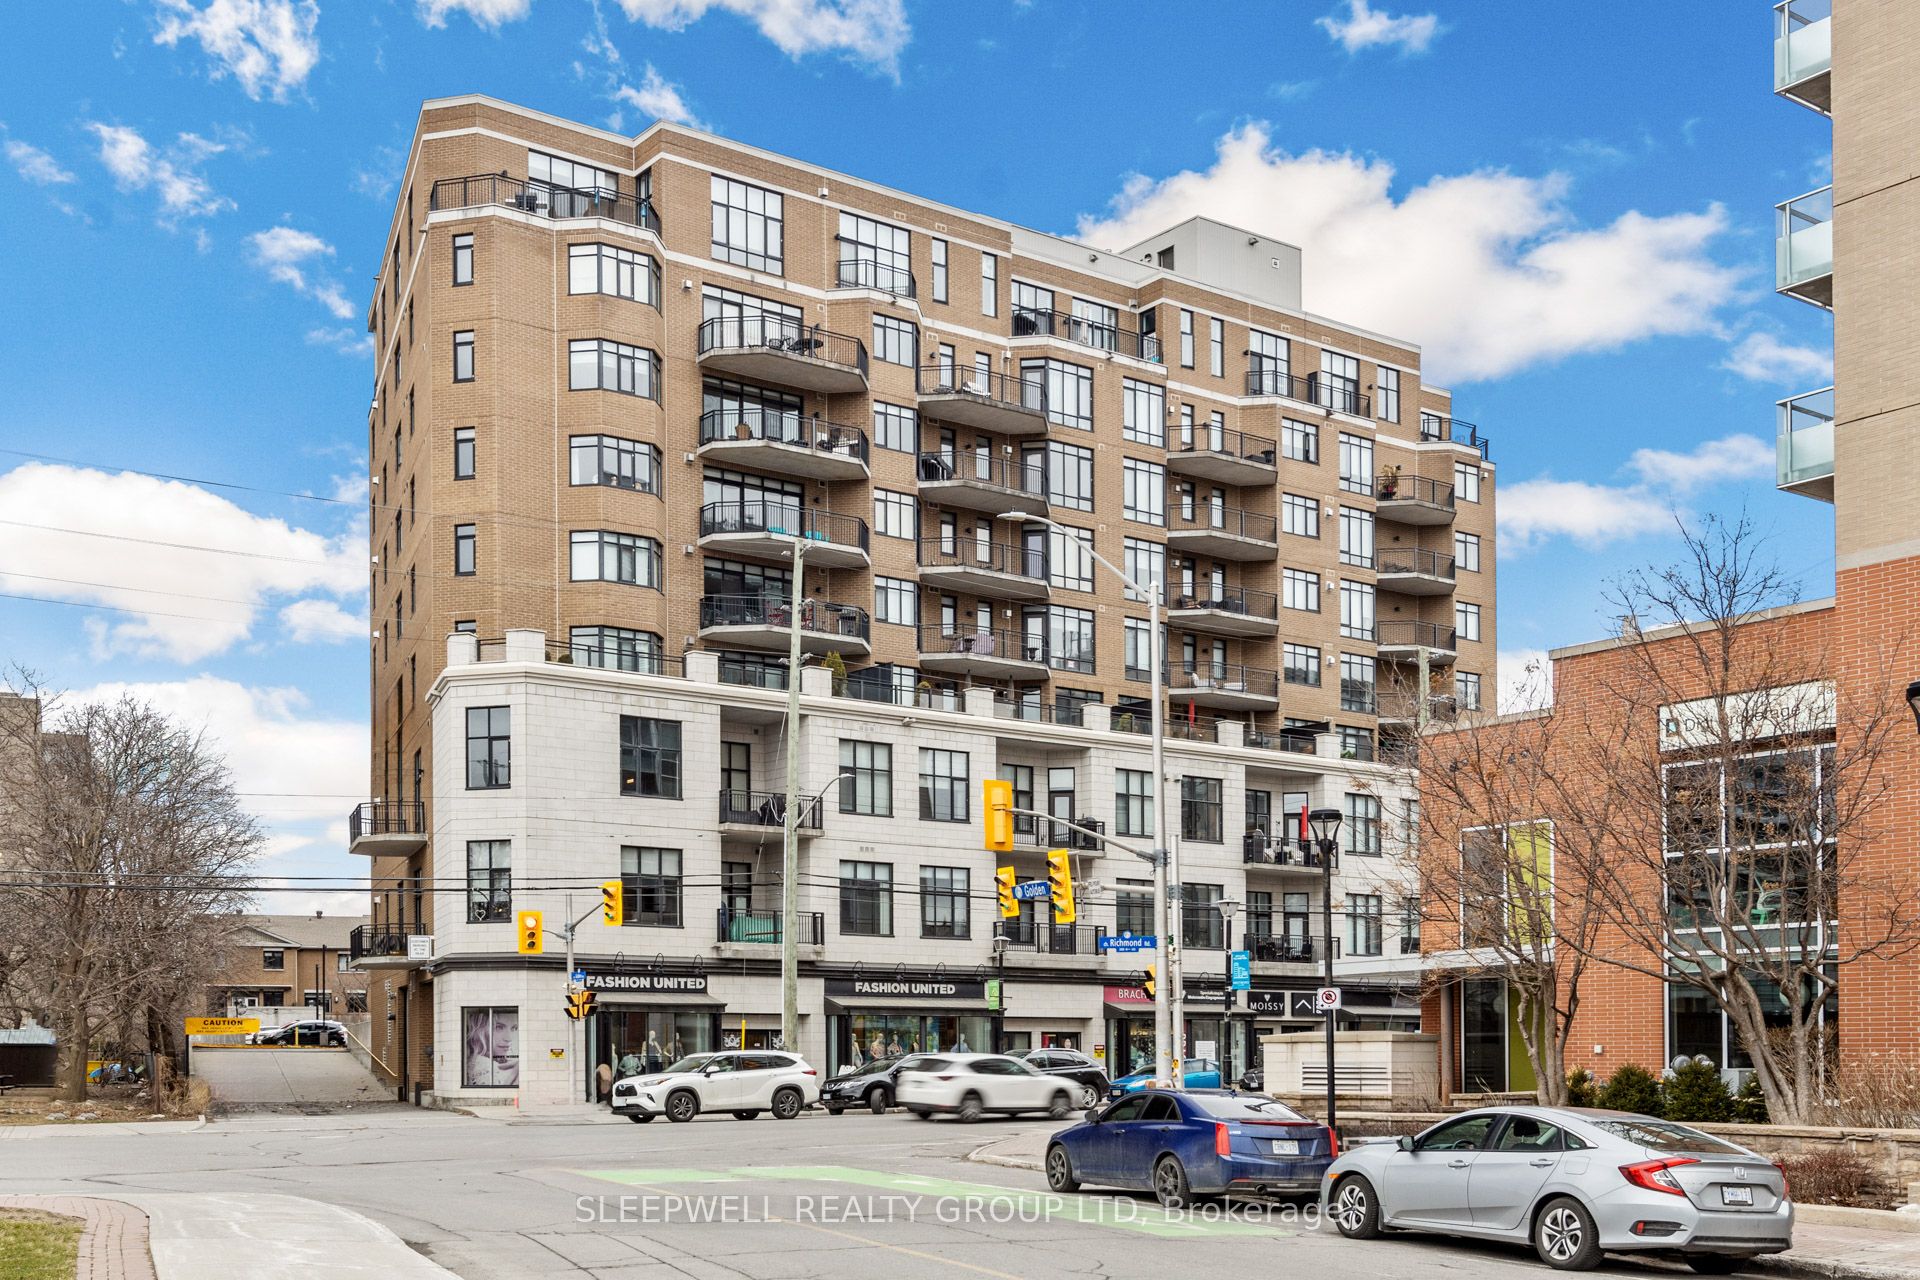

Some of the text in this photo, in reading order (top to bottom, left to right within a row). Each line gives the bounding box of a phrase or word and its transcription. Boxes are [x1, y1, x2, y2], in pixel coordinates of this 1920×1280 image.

[1024, 885, 1046, 897] Golden
[1110, 938, 1142, 947] Richmond
[586, 976, 650, 988] FASHION
[653, 978, 706, 989] UNITED
[855, 982, 956, 994] FASHION UNITED
[1250, 1002, 1284, 1011] MOISSY
